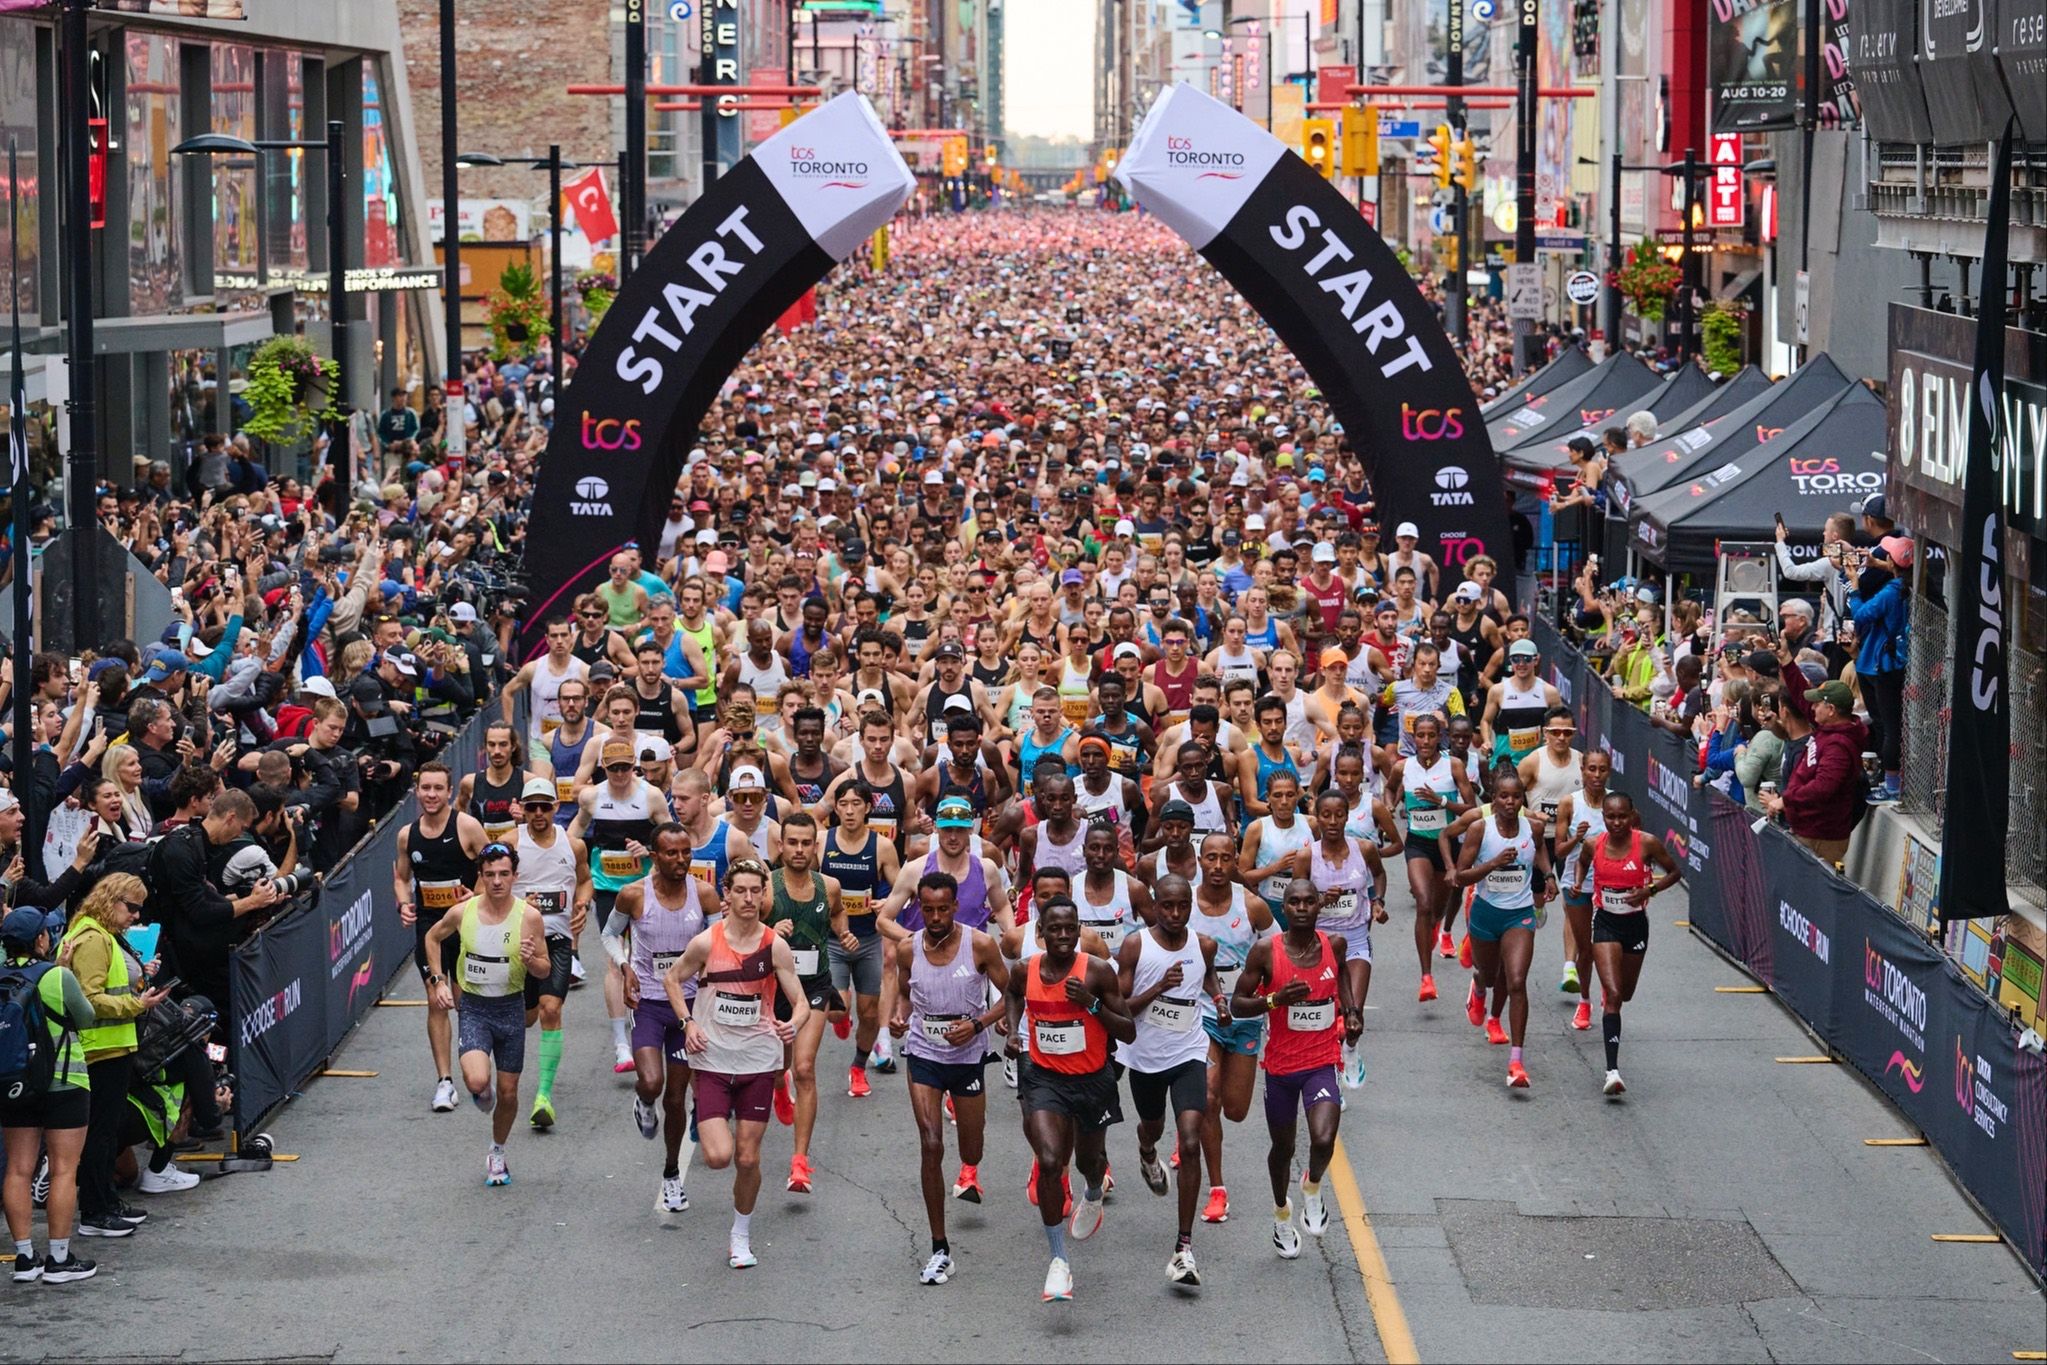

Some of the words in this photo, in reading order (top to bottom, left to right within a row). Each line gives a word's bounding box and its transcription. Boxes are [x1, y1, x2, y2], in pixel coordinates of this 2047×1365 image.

[1721, 87, 1748, 99] AUG
[1751, 86, 1786, 97] 10-20
[790, 161, 868, 174] TORONTO
[1167, 151, 1246, 165] TORONTO
[1715, 141, 1739, 206] ART
[344, 274, 438, 292] ERFORMANCE
[1269, 204, 1433, 379] START
[616, 204, 765, 395] START
[581, 409, 641, 451] tcs
[1401, 402, 1464, 441] tcs
[1899, 367, 1915, 467] 8
[1920, 372, 1972, 491] ELM
[1789, 457, 1840, 475] tcs
[1791, 472, 1887, 492] TORO
[1798, 487, 1879, 495] WATERFRONT
[1430, 492, 1475, 506] TATA
[569, 502, 614, 516] TATA
[1439, 531, 1467, 540] CHOOSE
[1413, 814, 1438, 823] NAGA
[341, 888, 374, 951] TORONTO
[467, 963, 487, 974] BEN
[1865, 936, 1882, 992] tcs
[1883, 961, 1927, 1032] TORONTO
[718, 1004, 758, 1016] ANDREW
[1151, 1005, 1181, 1021] PACE
[1292, 1011, 1322, 1021] PACE
[1864, 987, 1899, 1023] WATERFRONT
[1899, 1014, 1926, 1053] MARATHON
[1039, 1032, 1067, 1044] PACE
[1955, 1033, 1974, 1116] tcs
[1977, 1054, 1992, 1084] TATA
[1975, 1080, 2009, 1125] CONSULTANCY
[1974, 1104, 1996, 1139] SERVICES
